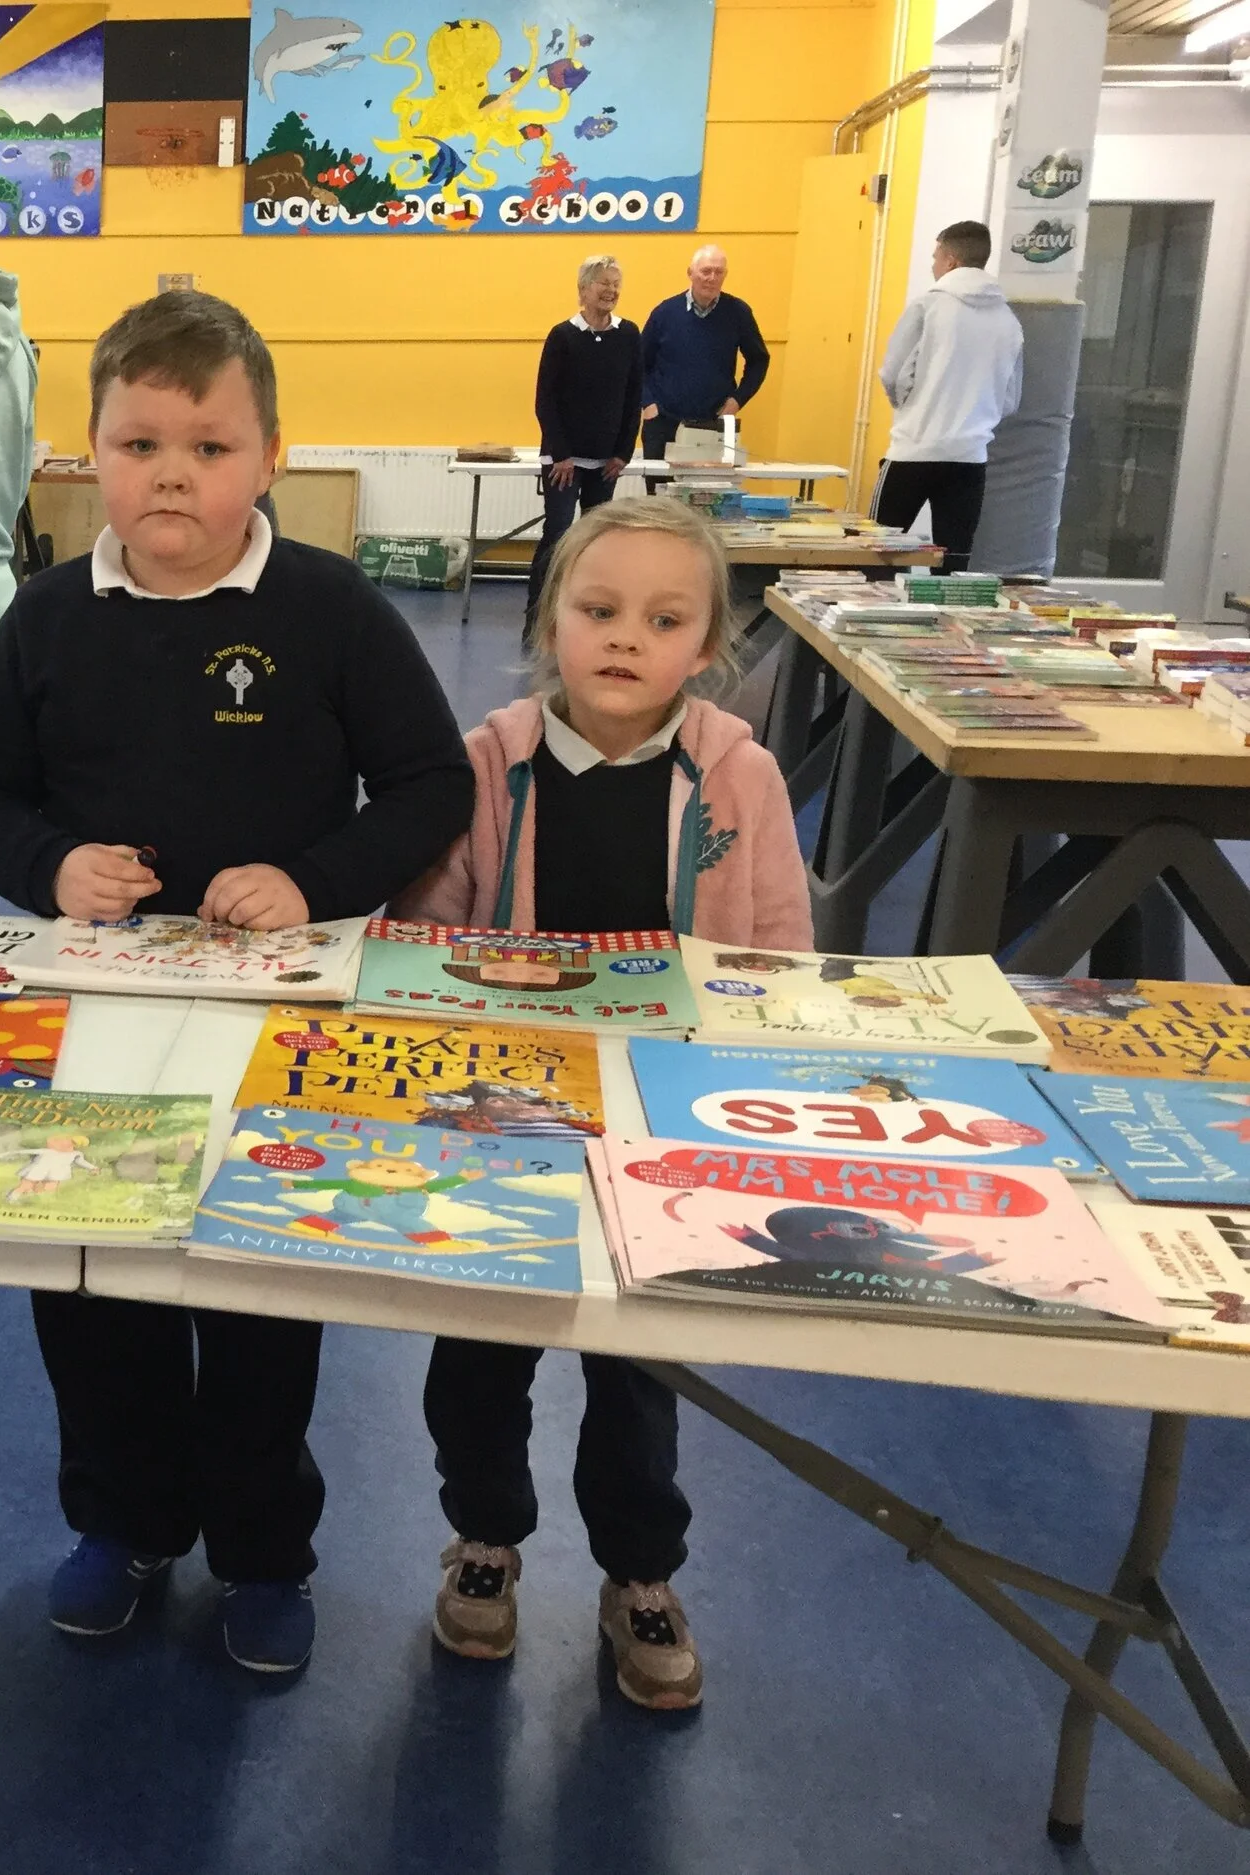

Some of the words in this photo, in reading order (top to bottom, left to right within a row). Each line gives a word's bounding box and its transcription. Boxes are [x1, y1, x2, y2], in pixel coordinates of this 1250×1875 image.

[1020, 165, 1081, 184] team
[502, 192, 676, 223] School
[1011, 225, 1078, 248] crawl
[379, 542, 430, 556] olivetti
[214, 710, 264, 723] Wicklow
[57, 946, 104, 959] IN
[113, 951, 217, 969] JOIN
[237, 959, 320, 972] ALL
[383, 988, 487, 1012] Peas
[498, 1002, 581, 1018] Your
[594, 1001, 669, 1018] Eat
[723, 999, 993, 1036] ALFIE
[291, 1018, 568, 1065] PIRATE'S
[284, 1047, 571, 1083] PERFECT
[710, 1049, 883, 1065] ALBOROUGH
[899, 1056, 937, 1067] JEZ
[278, 1068, 431, 1099] PET
[82, 1101, 164, 1118] Now
[271, 1098, 317, 1113] Matt
[319, 1104, 373, 1118] Myers
[1072, 1084, 1137, 1115] You
[32, 1109, 158, 1131] Dream
[720, 1099, 993, 1148] YES
[276, 1125, 418, 1157] YOU
[441, 1132, 502, 1151] Do
[1110, 1119, 1189, 1169] Love
[261, 1158, 308, 1169] FREE!
[692, 1149, 813, 1179] MRS
[836, 1163, 997, 1194] MOLE
[706, 1168, 784, 1195] I'M
[814, 1181, 1012, 1216] HOME!
[56, 1215, 154, 1225] OXENBURY
[218, 1232, 379, 1262] ANTHONY
[393, 1256, 535, 1284] BROWNE
[816, 1268, 954, 1292] JARVIS
[701, 1274, 738, 1284] FROM
[773, 1282, 829, 1293] CREATOR
[860, 1288, 917, 1301] ALAN'S
[962, 1298, 1016, 1311] SCARY
[1020, 1303, 1076, 1315] TEETH
